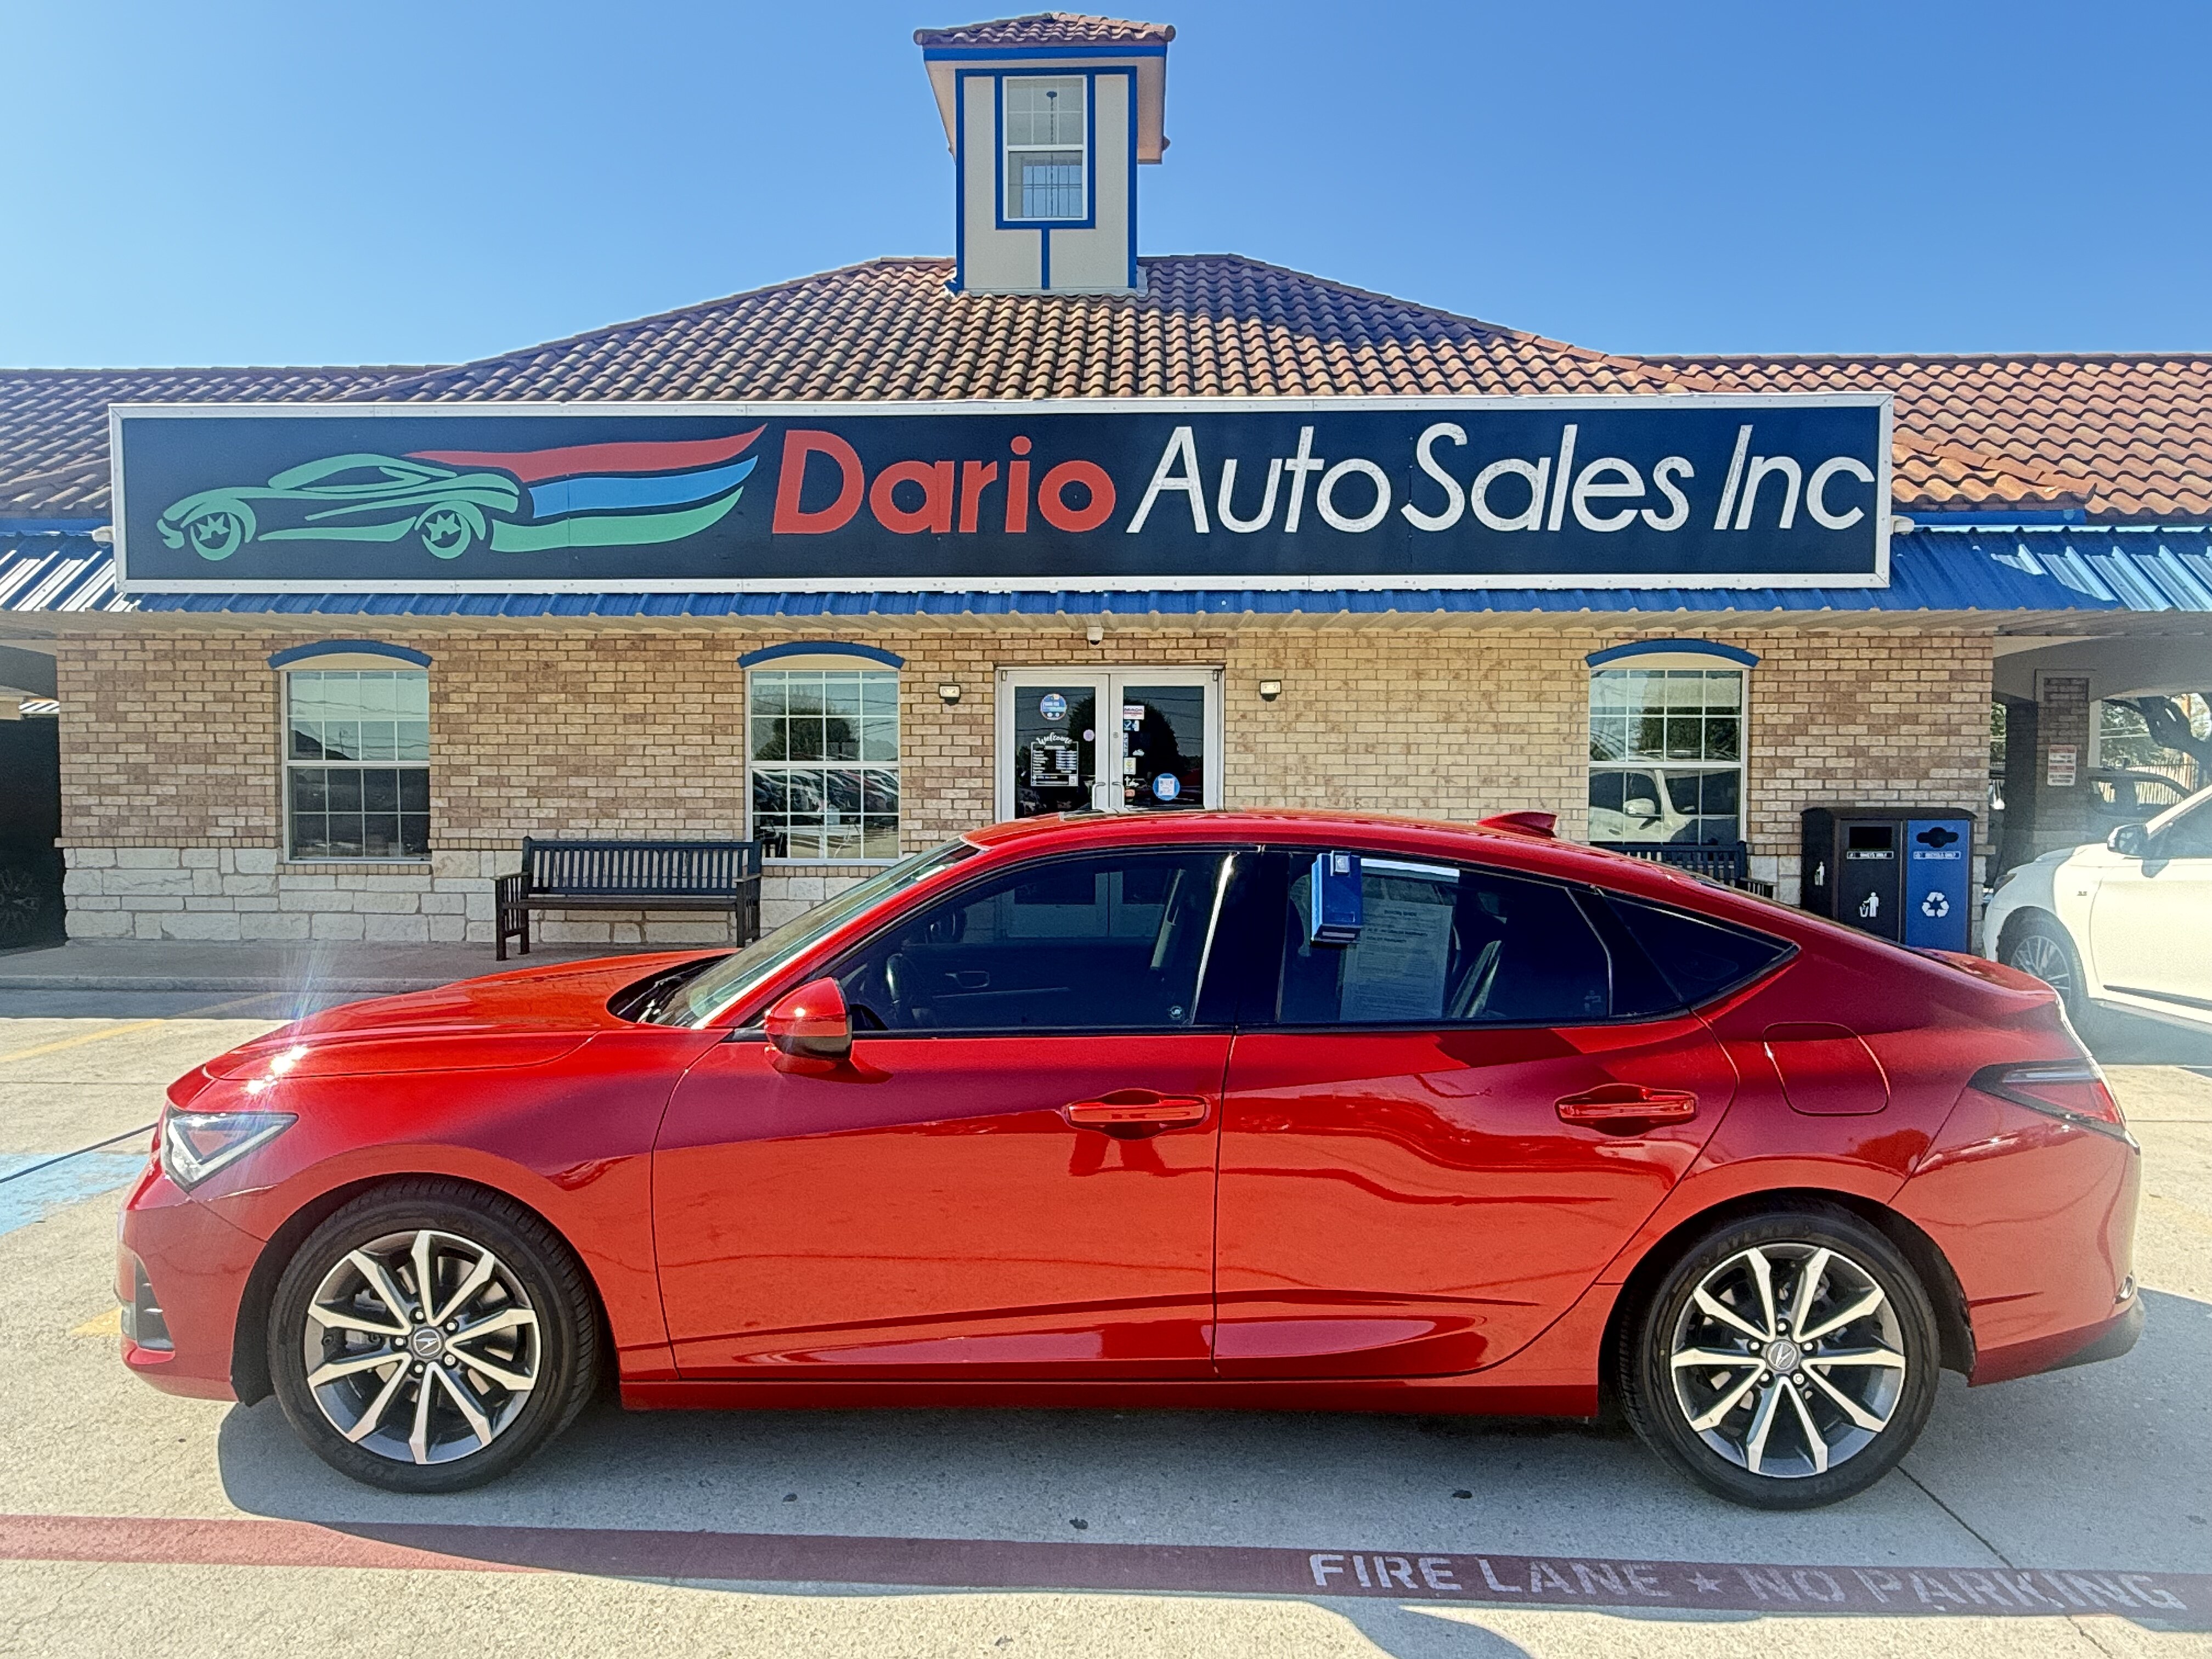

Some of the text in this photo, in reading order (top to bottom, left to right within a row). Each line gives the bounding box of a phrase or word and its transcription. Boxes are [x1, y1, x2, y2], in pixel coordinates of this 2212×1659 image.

[772, 422, 1875, 534] Dario Auto Sales Inc
[1309, 1554, 2188, 1611] FIRE LANE NO PARKING
